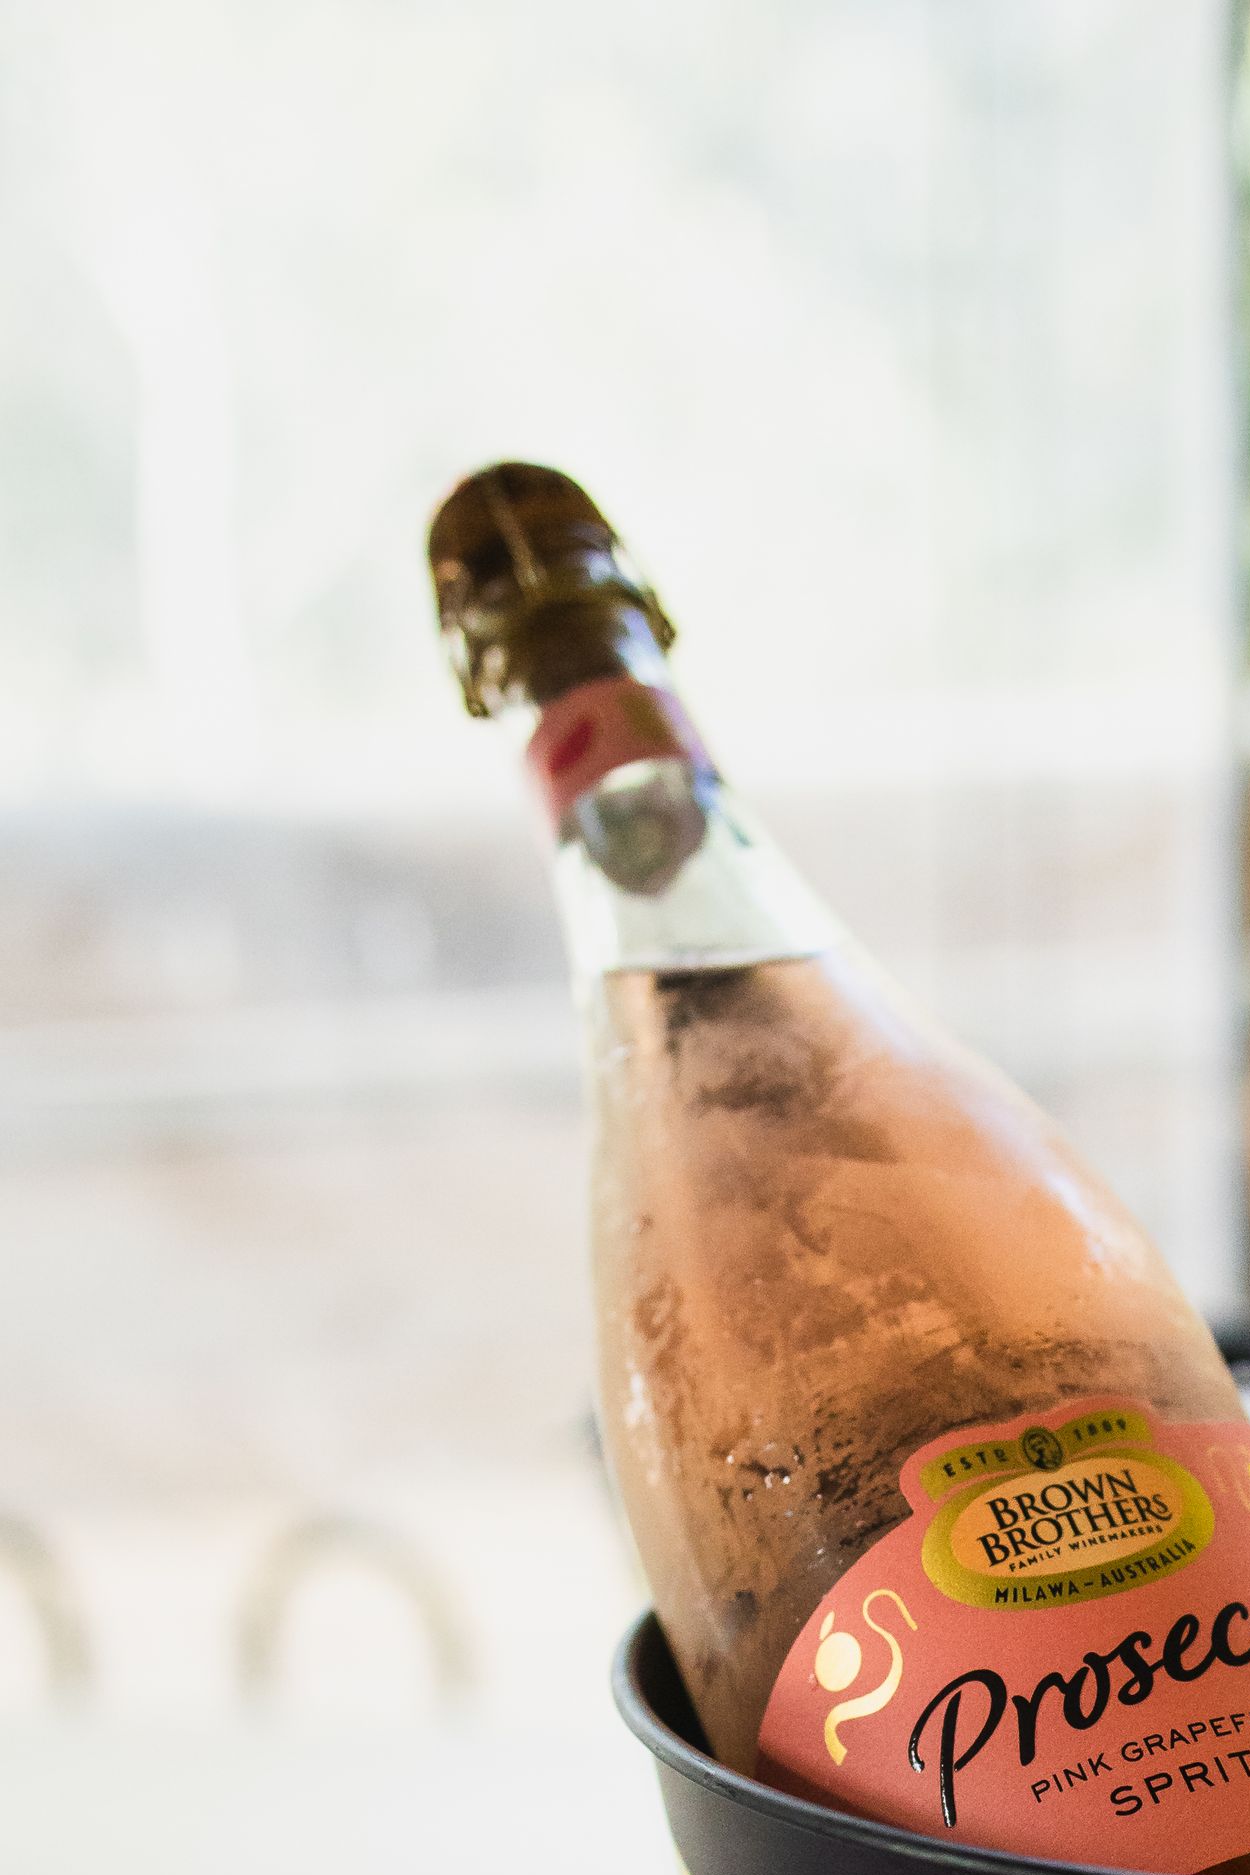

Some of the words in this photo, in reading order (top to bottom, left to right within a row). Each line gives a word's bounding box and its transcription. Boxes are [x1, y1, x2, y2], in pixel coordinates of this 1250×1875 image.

[986, 1469, 1138, 1531] BROWN
[977, 1493, 1173, 1567] BROTHERS
[1009, 1548, 1062, 1573] FAMILY
[1069, 1525, 1164, 1551] WINEMAKERS
[1030, 1753, 1110, 1803] PINK
